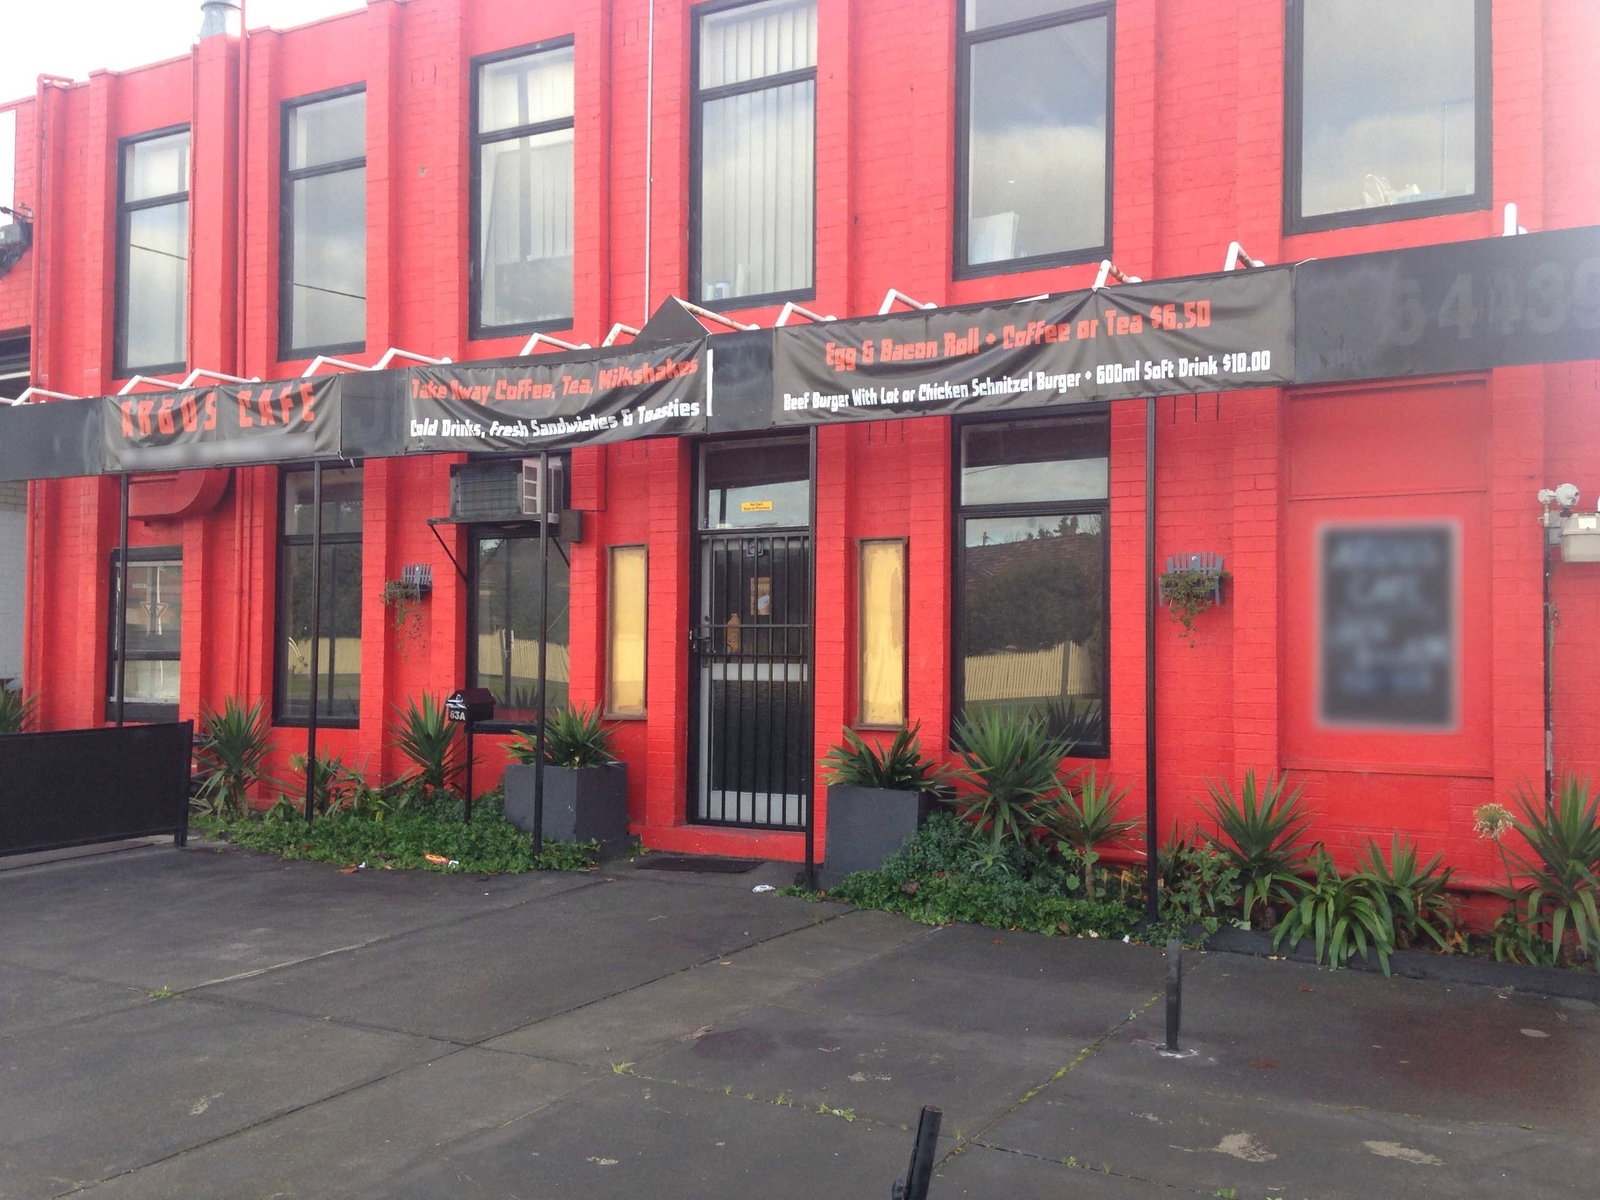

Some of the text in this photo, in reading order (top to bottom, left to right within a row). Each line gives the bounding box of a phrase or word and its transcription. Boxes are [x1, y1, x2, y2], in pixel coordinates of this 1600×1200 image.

[826, 341, 857, 371] Egg
[862, 339, 874, 363] &
[880, 338, 938, 362] Bacon
[944, 327, 979, 357] Roll
[1003, 320, 1071, 349] Coffee
[1077, 319, 1098, 339] or
[1105, 310, 1144, 336] Tea
[1150, 300, 1211, 331] $6.50
[412, 358, 698, 406] Take Away Coffee, Tea, Milkshakes
[783, 392, 809, 411] Beef
[812, 390, 849, 412] Burger
[852, 387, 877, 406] With
[880, 386, 899, 405] Lot
[902, 389, 915, 403] or
[918, 379, 968, 402] Chicken
[972, 371, 1032, 397] Schnitzel
[1036, 371, 1081, 393] Burger
[1097, 360, 1140, 384] 600ml
[1144, 359, 1174, 381] Soft
[1179, 355, 1217, 378] Drink
[1222, 350, 1271, 374] $10.00
[119, 382, 316, 437] ARGUS CAFE
[410, 399, 700, 438] Cold Drinks, Fresh Sandwiches & Toasties
